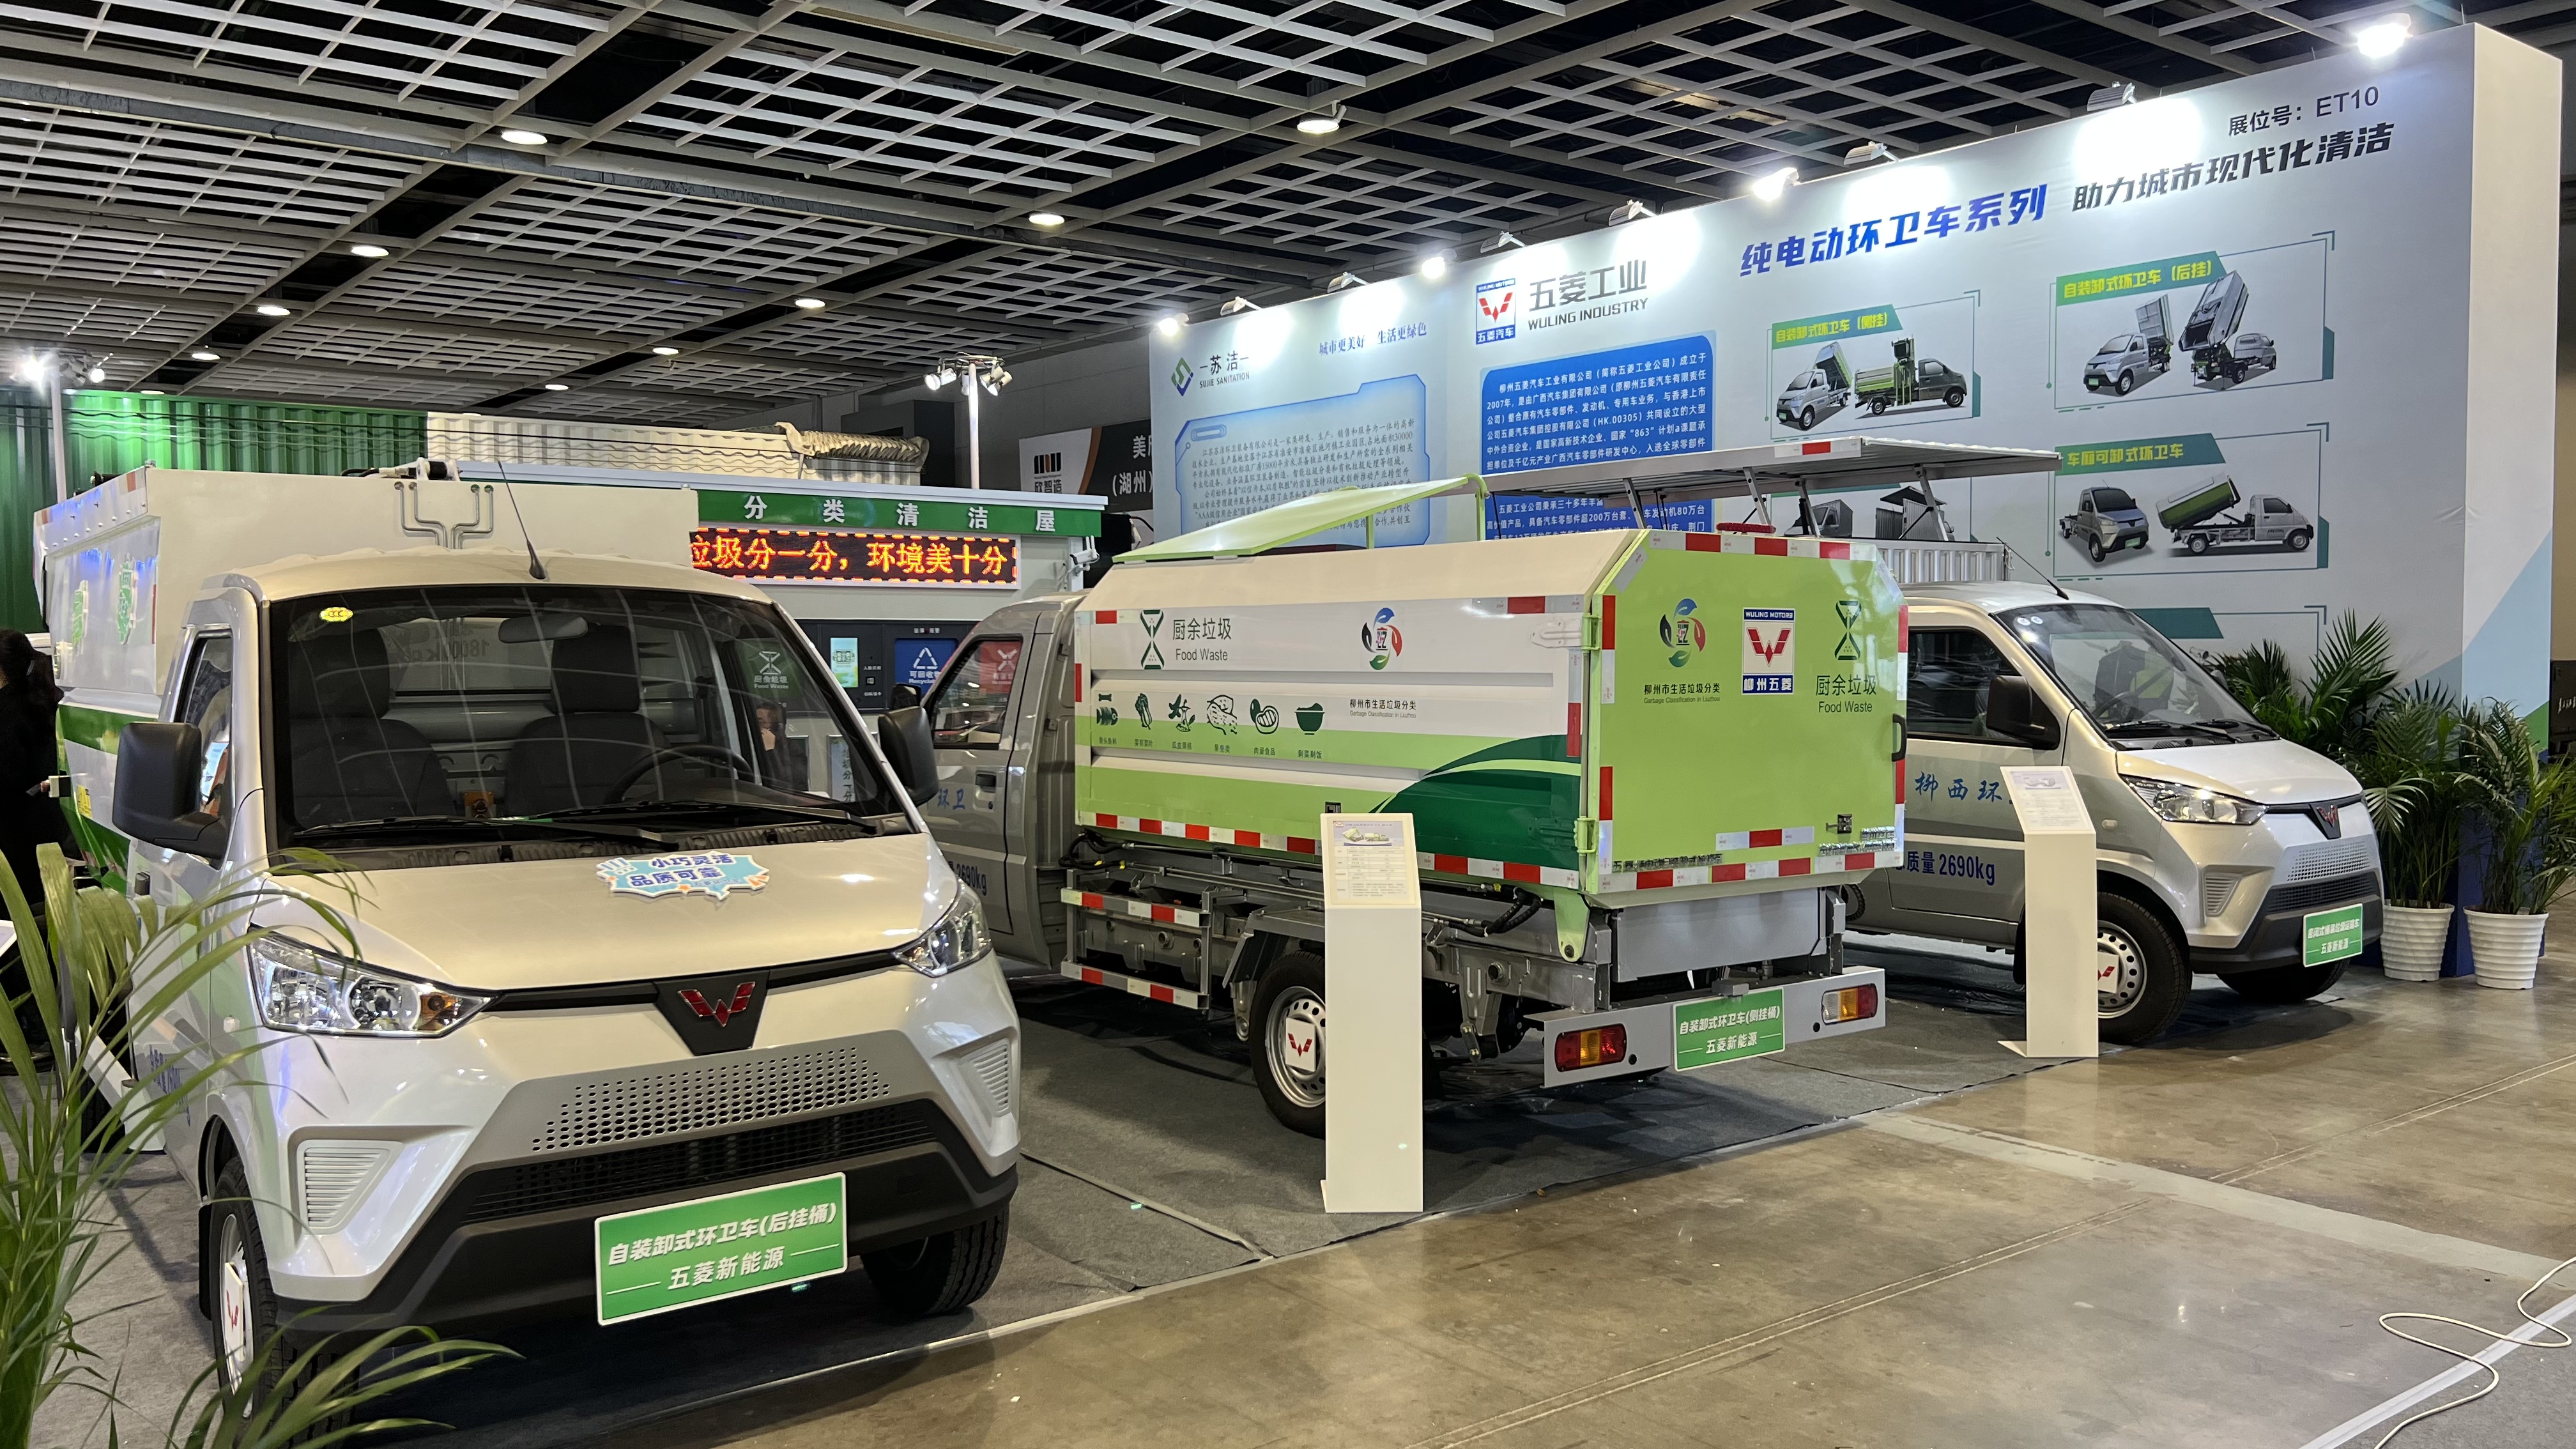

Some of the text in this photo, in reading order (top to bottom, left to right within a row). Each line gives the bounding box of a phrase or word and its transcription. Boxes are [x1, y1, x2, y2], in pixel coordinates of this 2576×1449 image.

[1739, 121, 2395, 278] 纯电动环卫车系列 助力城市现代化清洁
[1529, 259, 1648, 313] 五菱工业
[1528, 297, 1648, 331] WULING INDUSTRY
[1319, 321, 1427, 356] 城市更美好 生活更绿色
[1477, 326, 1515, 344] 五菱汽车
[1199, 371, 1250, 389] SUJIE SANITATION
[1133, 434, 1153, 459] 美
[2067, 443, 2184, 467] 车厢可卸式环卫车
[744, 495, 1055, 532] 分类清洁屋
[1745, 611, 1793, 620] WULING MOTORS
[1172, 617, 1232, 641] 厨余垃圾
[1176, 648, 1229, 661] Food Waste
[1644, 682, 1721, 696] 柳州市生活垃圾分类
[1744, 677, 1793, 692] 柳州五菱
[1816, 675, 1876, 697] 厨余垃圾
[1349, 698, 1416, 710] 柳州市生活垃圾分类
[1818, 700, 1873, 714] Food Waste
[1914, 770, 2012, 805] 柳西环
[652, 854, 734, 868] 小巧灵活
[629, 866, 723, 887] 品质可靠
[1705, 1031, 1758, 1055] 五菱新能源
[666, 1245, 785, 1291] 五菱新能源
